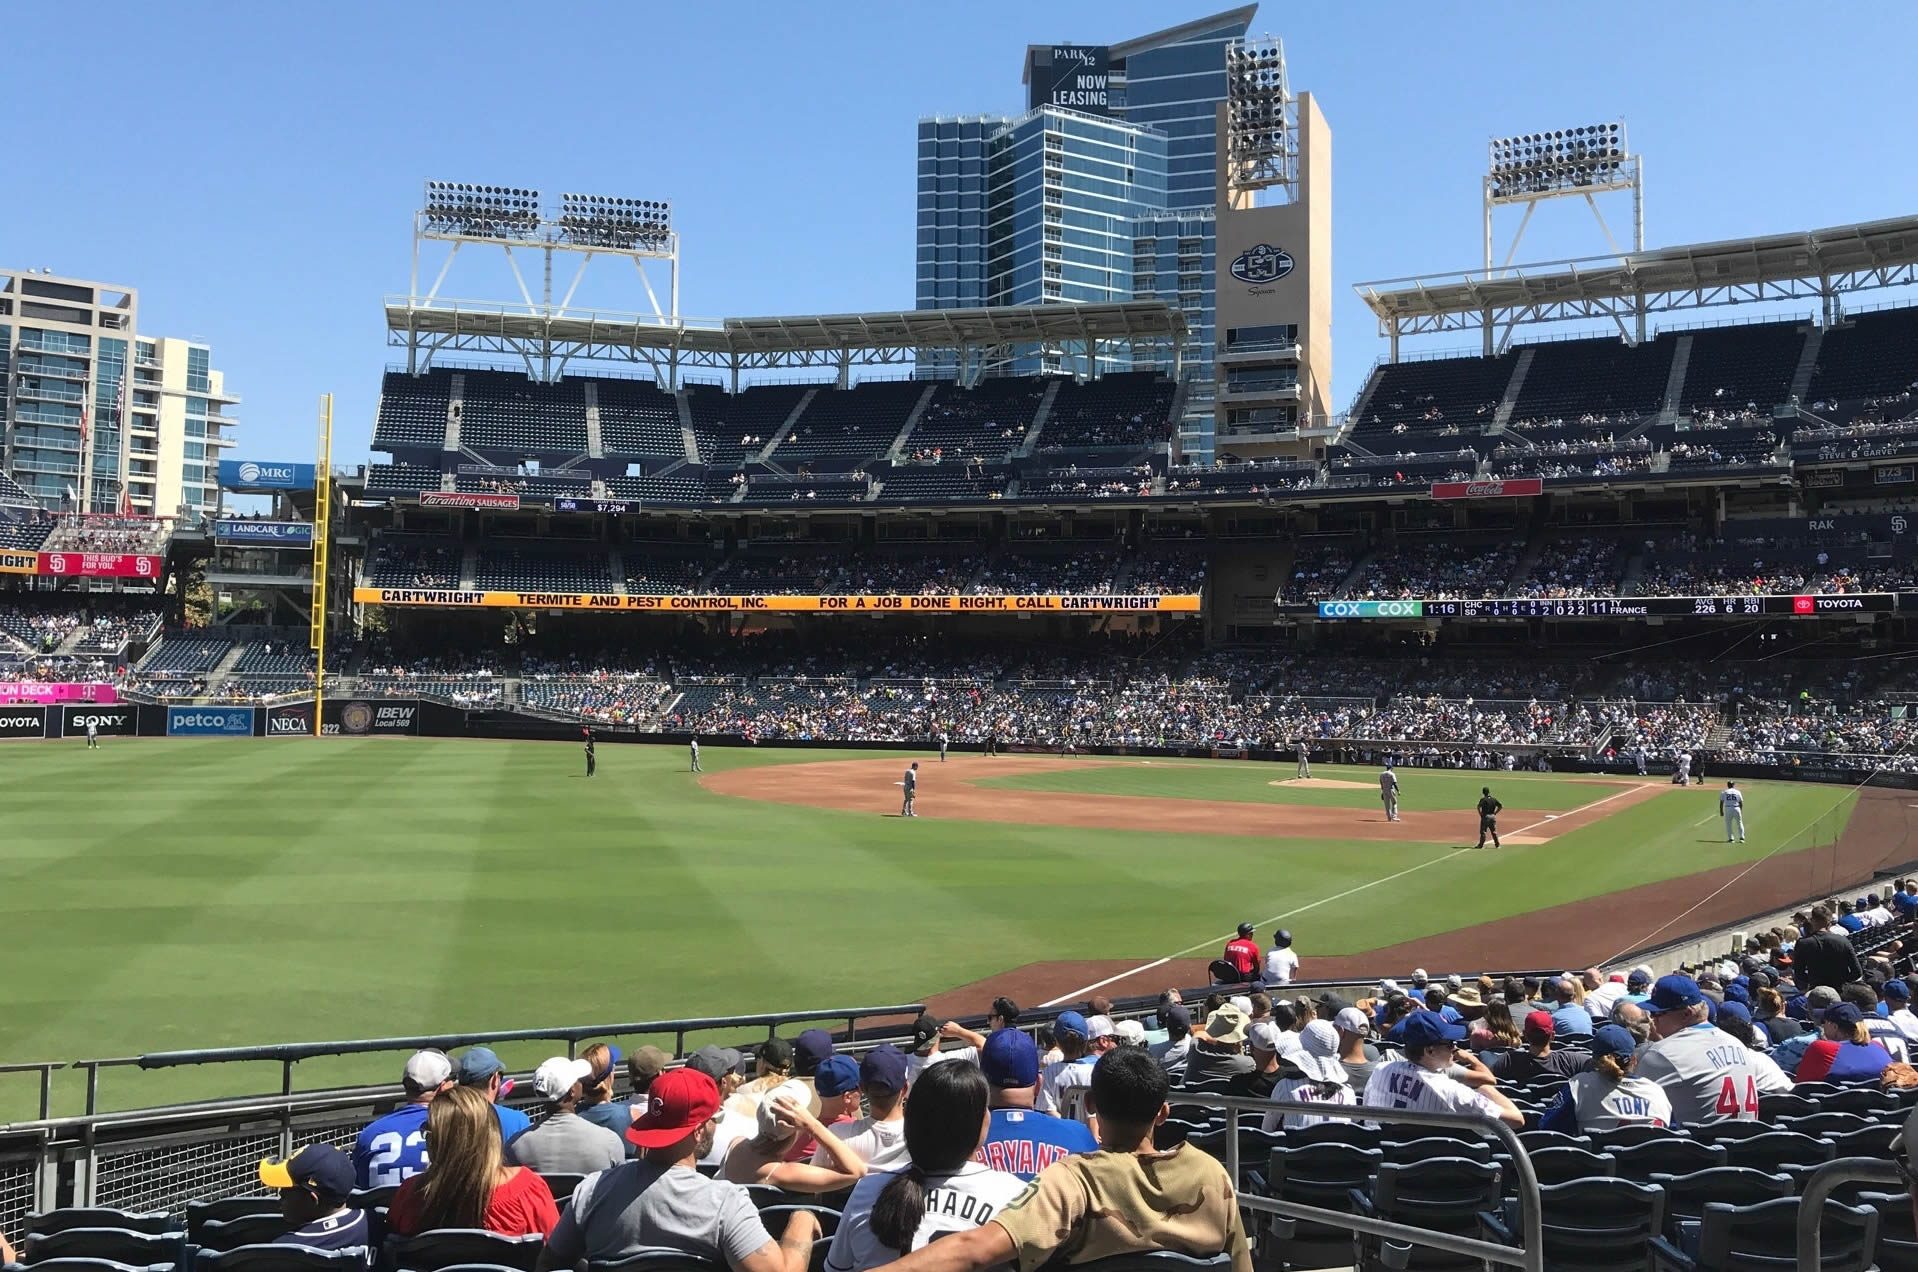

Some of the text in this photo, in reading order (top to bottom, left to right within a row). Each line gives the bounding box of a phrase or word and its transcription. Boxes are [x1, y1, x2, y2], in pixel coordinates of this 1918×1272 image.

[1054, 48, 1086, 59] PARK
[1077, 74, 1107, 89] NOW
[1053, 91, 1107, 105] LEASING
[1818, 448, 1898, 460] STEVE 6 GARVEY
[260, 467, 291, 478] MRC
[421, 494, 518, 508] Tarantino SAUSAGES
[597, 503, 626, 513] $7,294
[233, 524, 280, 535] LANDCARE
[282, 525, 311, 535] LOGIC
[1809, 519, 1834, 530] RAK
[1891, 515, 1907, 534] SD
[83, 554, 123, 563] THIS BUD'S
[98, 562, 115, 570] YOU.
[381, 590, 1160, 611] CARTWRIGHT TERMITE AND PEST CONTROL, INC. FOR A JOB DONE RIGHT, CALL CARTWRIGHT
[1743, 597, 1760, 605] RBI
[1816, 599, 1863, 609] TOYOTA
[1323, 602, 1415, 616] COX COX
[1428, 603, 1455, 615] 1:16
[1464, 608, 1477, 616] SD
[1493, 608, 1499, 616] 0
[1542, 606, 1550, 616] 2
[1556, 606, 1585, 615] 0 2 2
[1591, 601, 1607, 614] 11
[1610, 607, 1648, 615] FRANCE
[1691, 604, 1759, 614] .226 6 20
[21, 685, 54, 696] DECK
[376, 707, 416, 719] IBEW
[0, 717, 40, 728] OYOTA
[73, 714, 128, 728] SONY
[173, 712, 224, 730] petco
[271, 717, 308, 731] NECA
[374, 719, 411, 727] Local 569
[321, 723, 340, 734] 322
[1705, 1045, 1747, 1070] RIZZO
[1715, 1074, 1759, 1120] 44
[1612, 1097, 1651, 1117] TONY
[368, 1130, 432, 1187] 23
